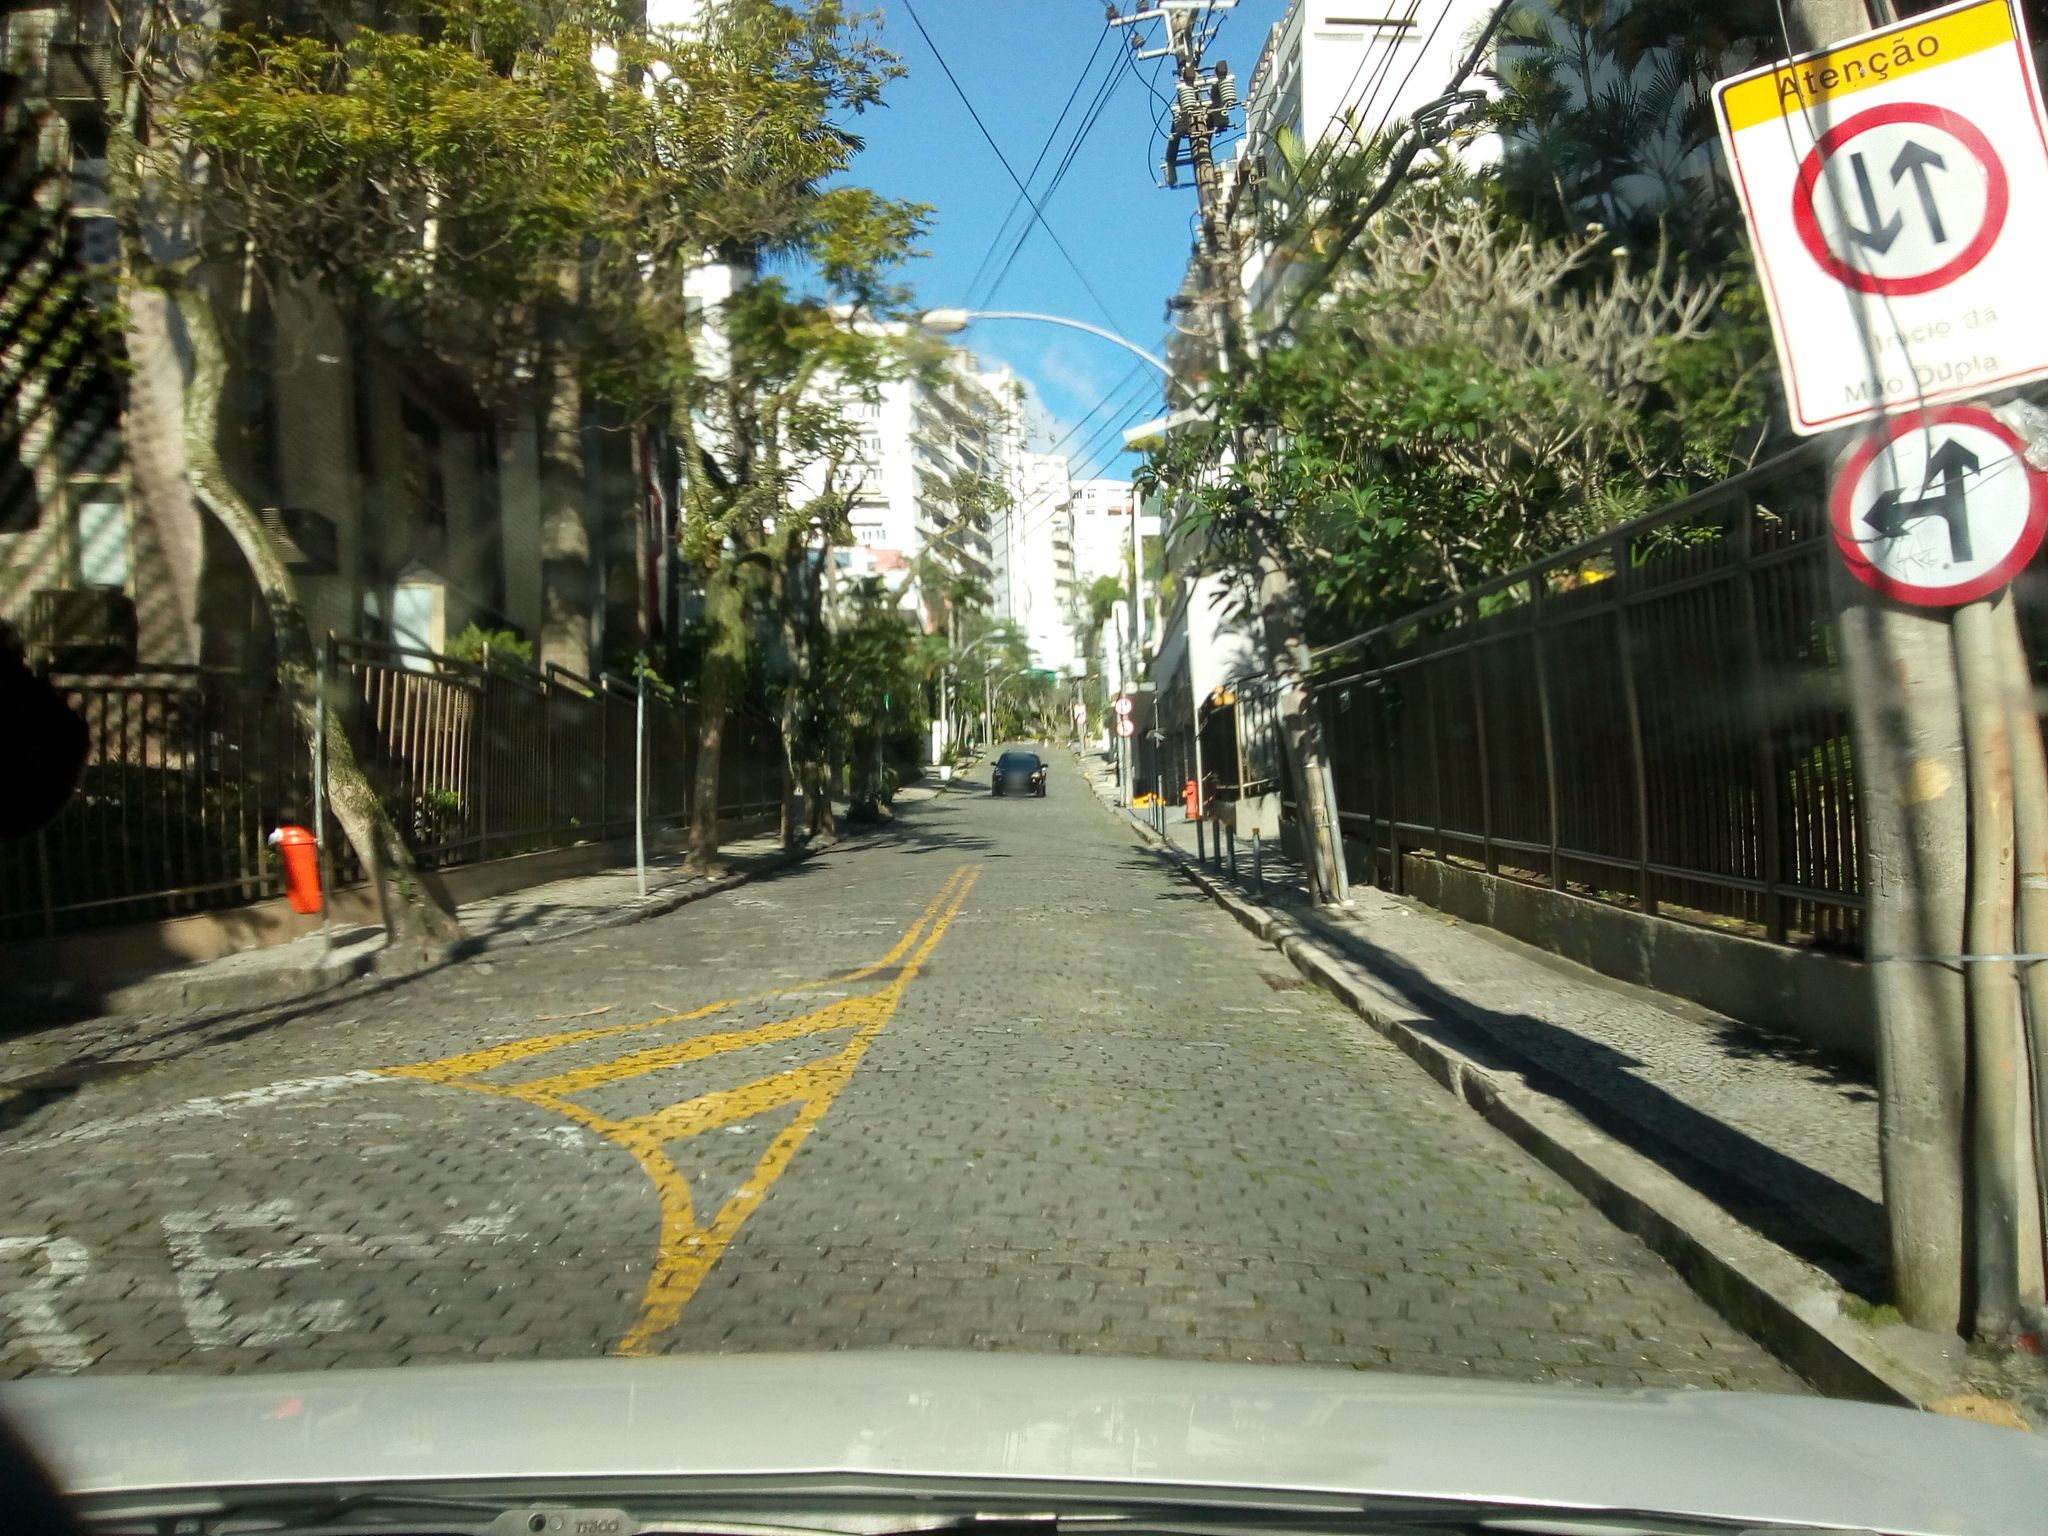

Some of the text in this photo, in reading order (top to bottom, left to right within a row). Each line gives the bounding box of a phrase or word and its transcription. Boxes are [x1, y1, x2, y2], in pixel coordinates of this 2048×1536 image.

[1779, 35, 1939, 105] Atenção
[1844, 353, 1999, 403] Mo Dupla
